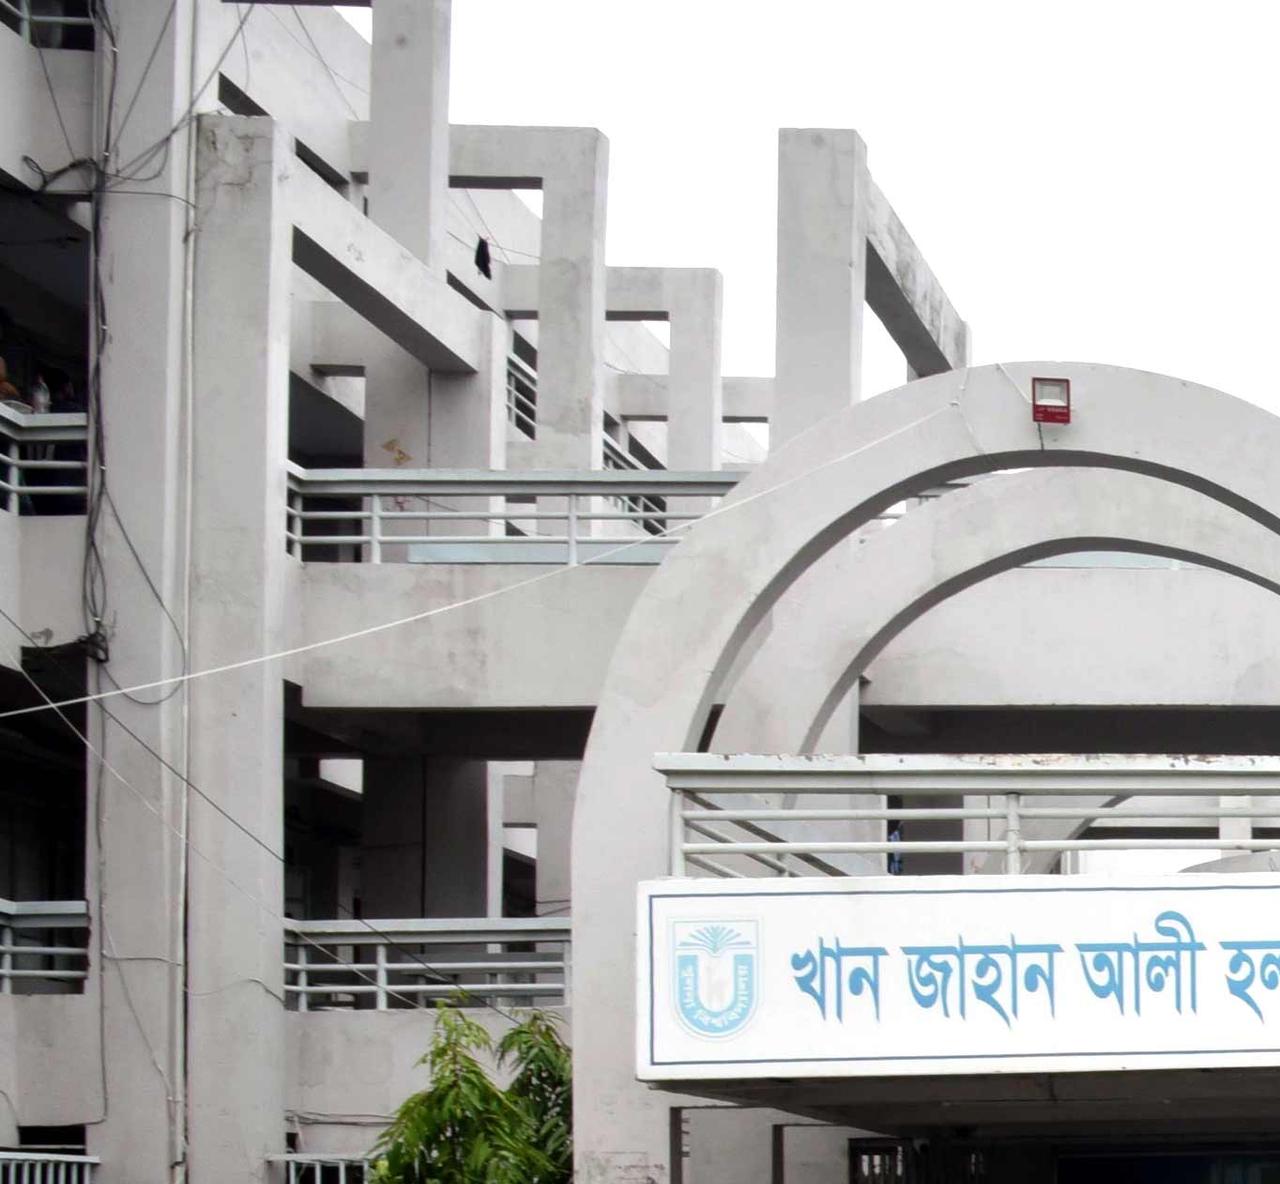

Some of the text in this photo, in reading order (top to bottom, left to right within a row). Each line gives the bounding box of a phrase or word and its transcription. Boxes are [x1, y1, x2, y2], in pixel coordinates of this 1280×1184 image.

[791, 937, 888, 1023] খান
[902, 933, 1063, 1029] জাহান
[1077, 911, 1207, 1016] আলী
